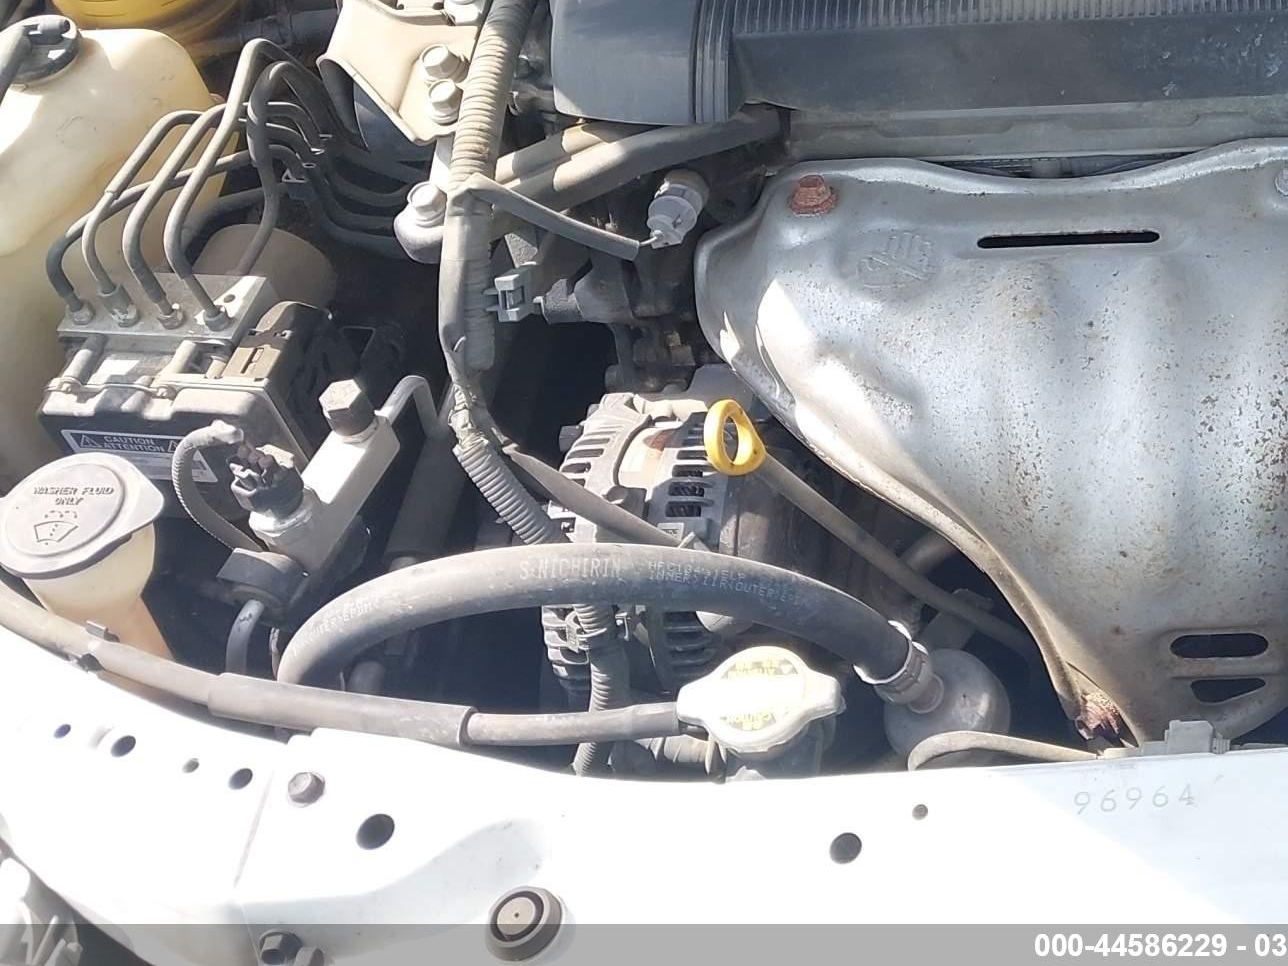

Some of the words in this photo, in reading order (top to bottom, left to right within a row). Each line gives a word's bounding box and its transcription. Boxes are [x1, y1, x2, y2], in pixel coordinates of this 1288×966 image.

[103, 435, 155, 445] CAUTION
[103, 442, 166, 453] ATTENTION
[33, 486, 78, 495] WASHER
[81, 486, 115, 495] FLUID
[54, 497, 84, 506] ONLY
[1073, 783, 1195, 815] 96964
